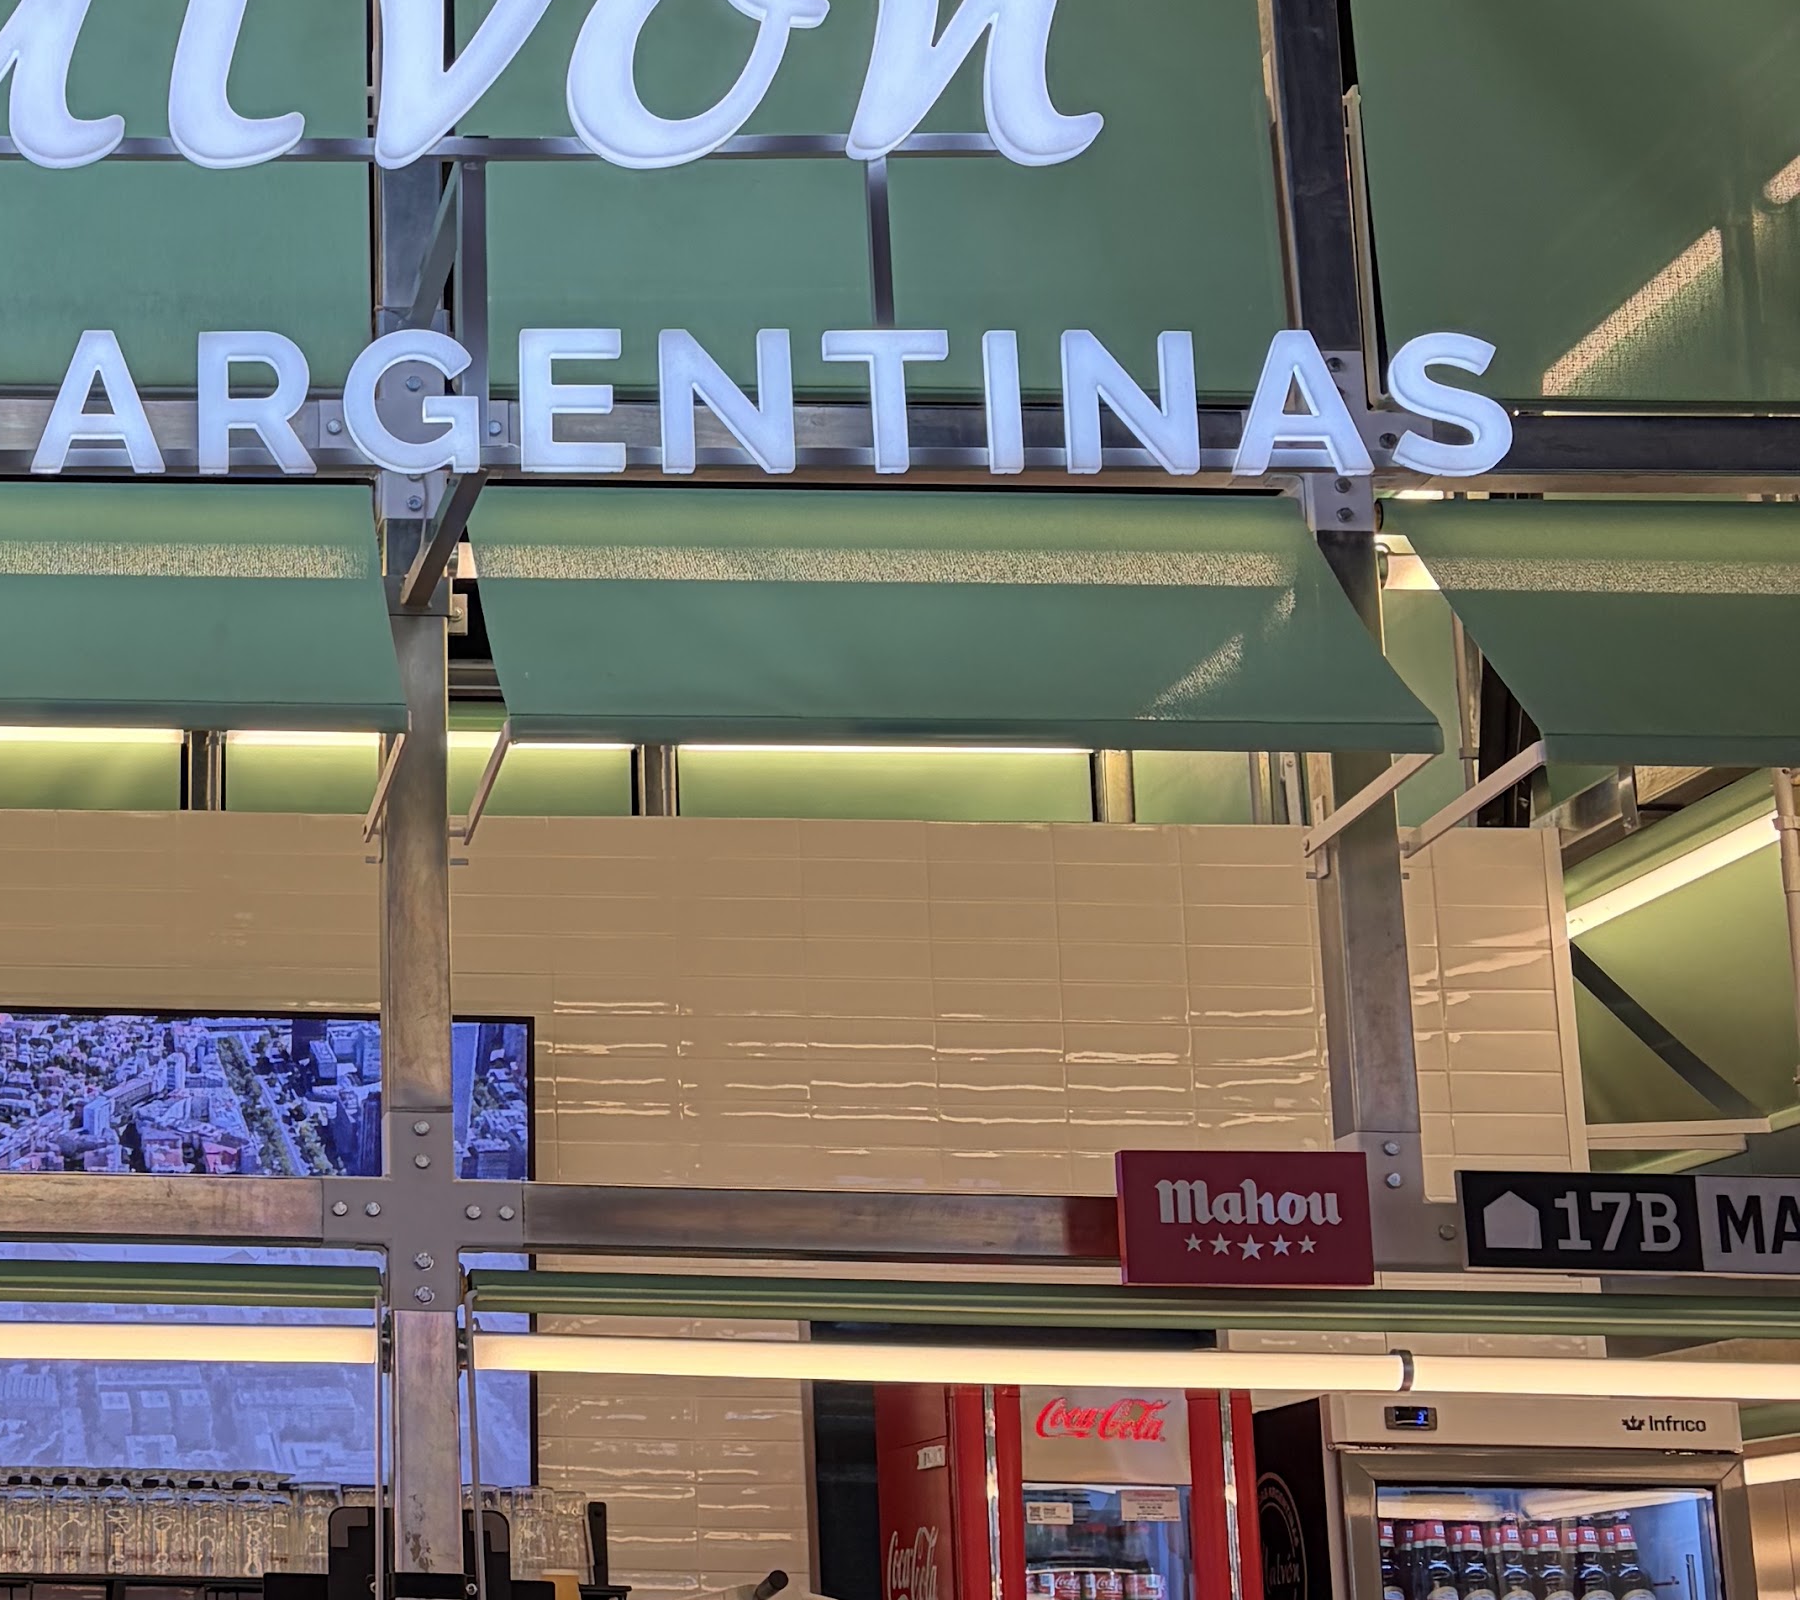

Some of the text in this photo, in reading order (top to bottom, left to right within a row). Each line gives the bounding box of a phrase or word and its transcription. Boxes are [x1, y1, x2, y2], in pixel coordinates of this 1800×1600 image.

[26, 325, 1518, 482] ARGENTINAS
[1154, 1178, 1342, 1227] Mahou
[1555, 1191, 1681, 1253] 17B
[1035, 1397, 1171, 1442] Coca-Cola
[1650, 1416, 1707, 1433] Infrico
